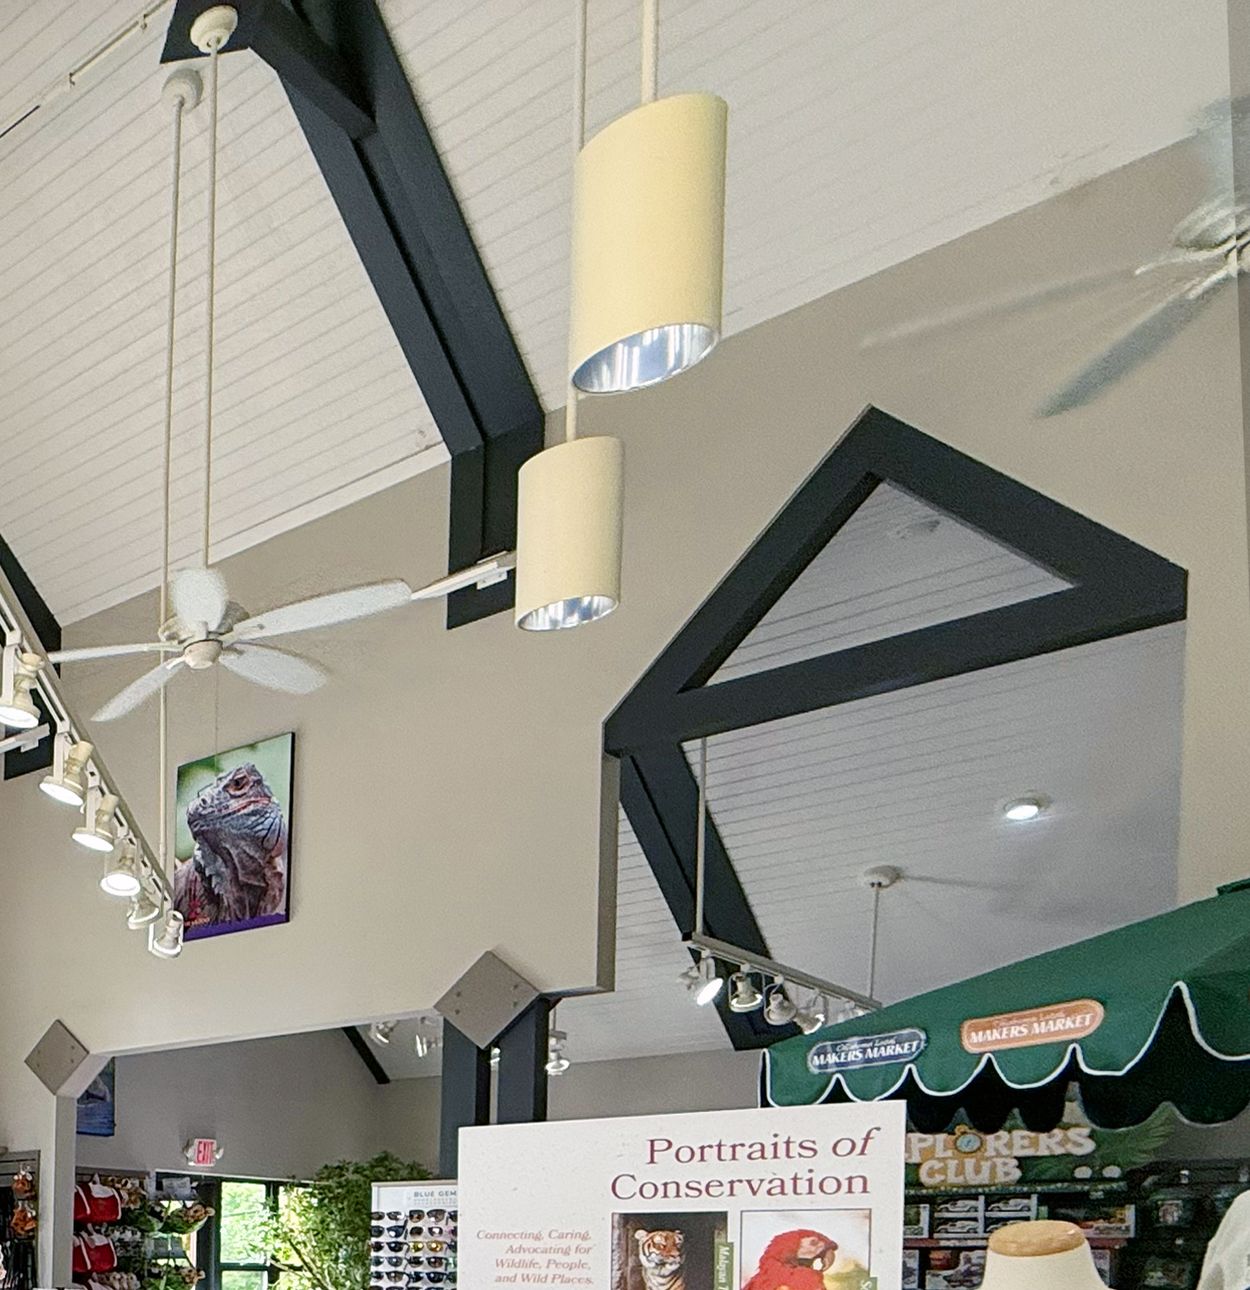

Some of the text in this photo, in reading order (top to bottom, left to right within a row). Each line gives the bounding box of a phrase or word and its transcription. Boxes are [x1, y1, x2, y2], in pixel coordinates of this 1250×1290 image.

[969, 1013, 1093, 1043] MAKERS MARKET
[812, 1040, 919, 1066] MAKERS MARKET
[196, 1140, 214, 1164] EXIT
[645, 1126, 881, 1165] Portraits of
[905, 1127, 1096, 1163] PLORERS
[610, 1168, 870, 1200] Conservation
[919, 1156, 1022, 1187] CLUB
[413, 1190, 434, 1198] BLUE
[505, 1243, 592, 1257] Advocating for
[717, 1245, 730, 1283] Malayan
[495, 1258, 591, 1271] Wildlife, People,
[495, 1273, 594, 1285] and Wild Places.
